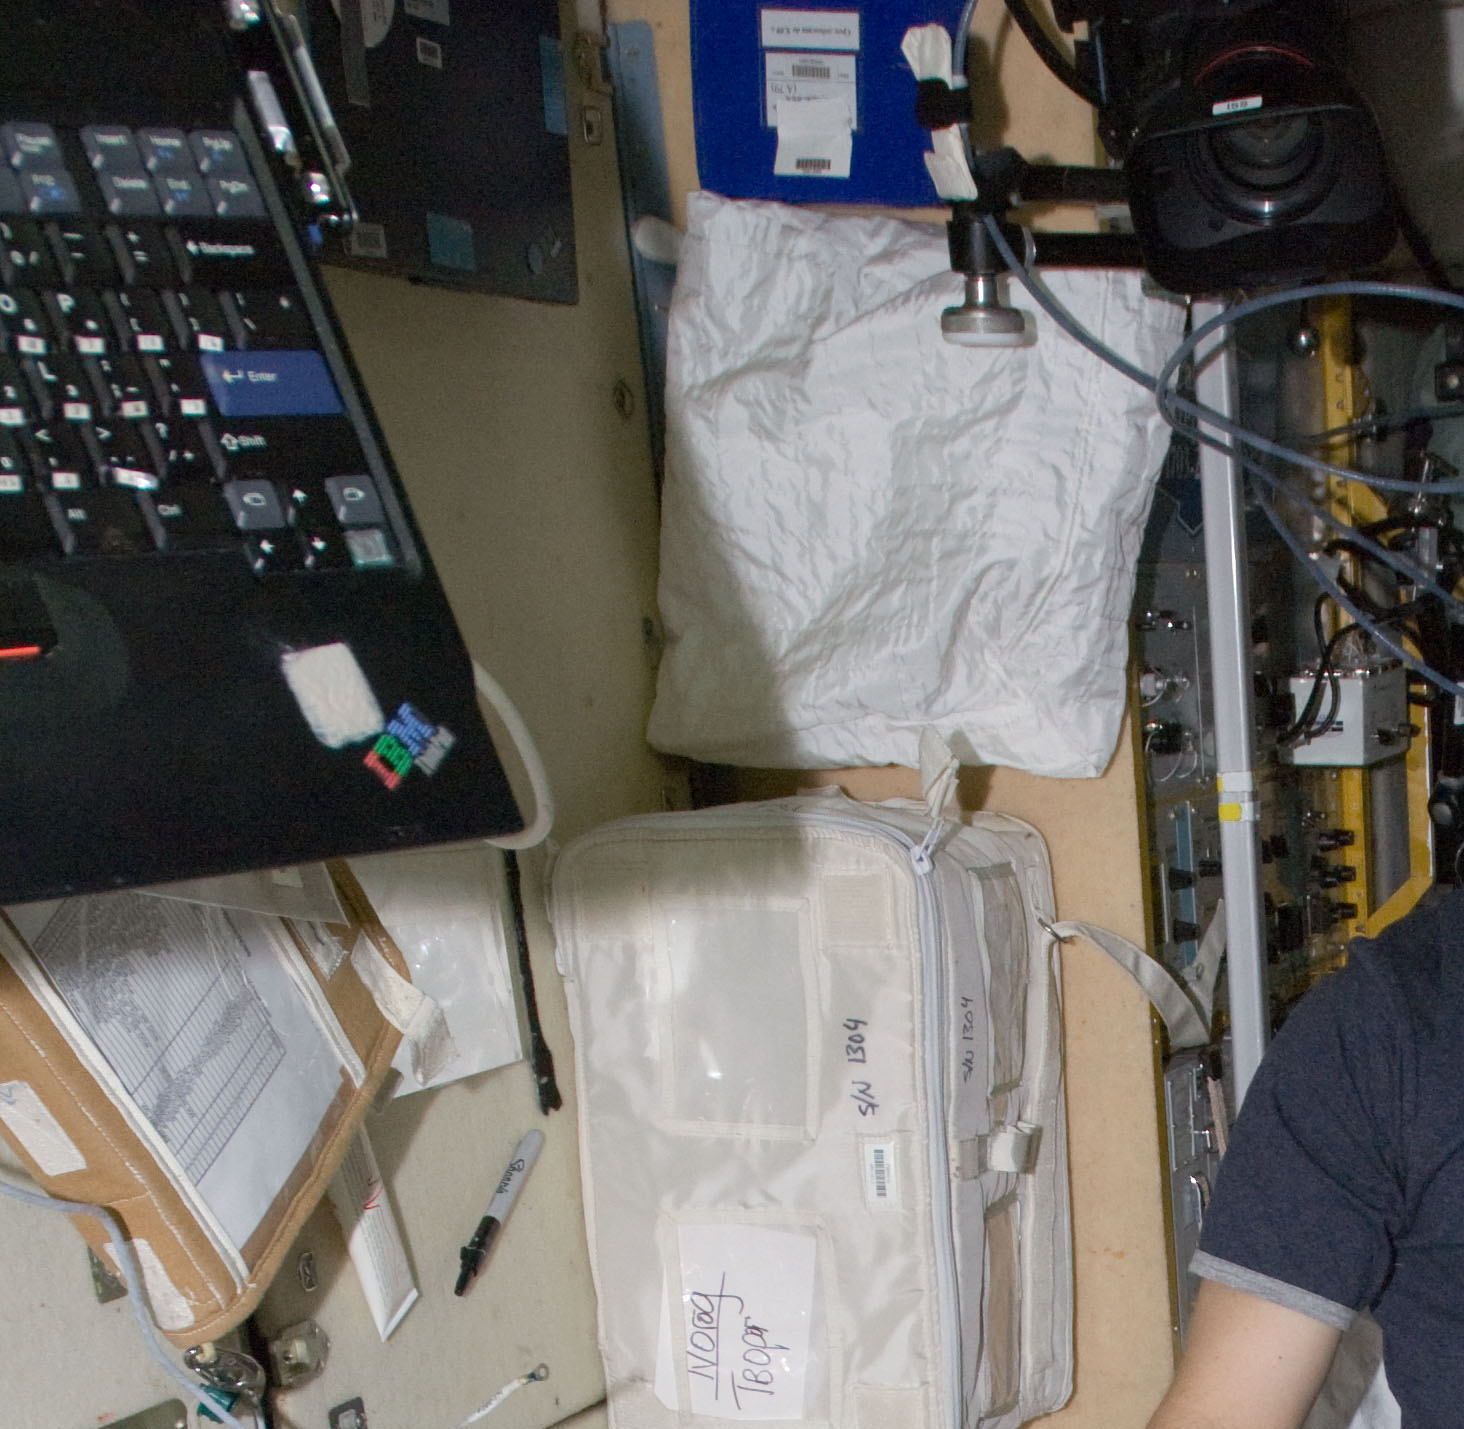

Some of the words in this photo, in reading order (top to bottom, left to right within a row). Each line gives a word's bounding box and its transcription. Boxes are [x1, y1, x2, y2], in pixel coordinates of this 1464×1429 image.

[960, 996, 975, 1041] 1304
[842, 1017, 868, 1064] 1304
[961, 1049, 975, 1084] S/N
[850, 1080, 880, 1117] S/N
